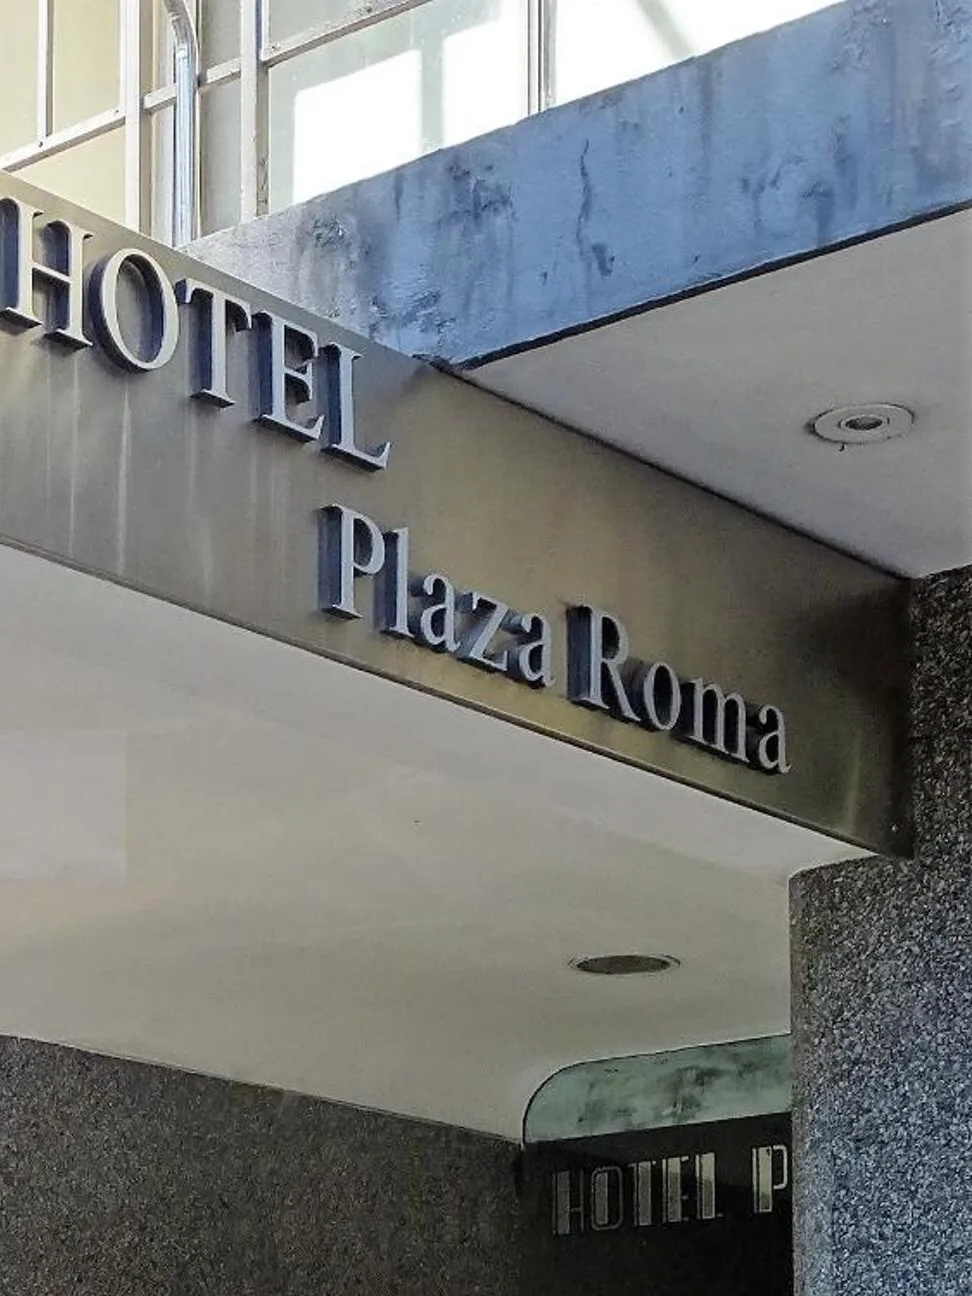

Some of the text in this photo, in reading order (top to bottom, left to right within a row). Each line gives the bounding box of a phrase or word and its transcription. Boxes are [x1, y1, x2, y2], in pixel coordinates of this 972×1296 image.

[318, 503, 792, 775] Plaza Roma
[552, 1152, 724, 1236] HOTEL
